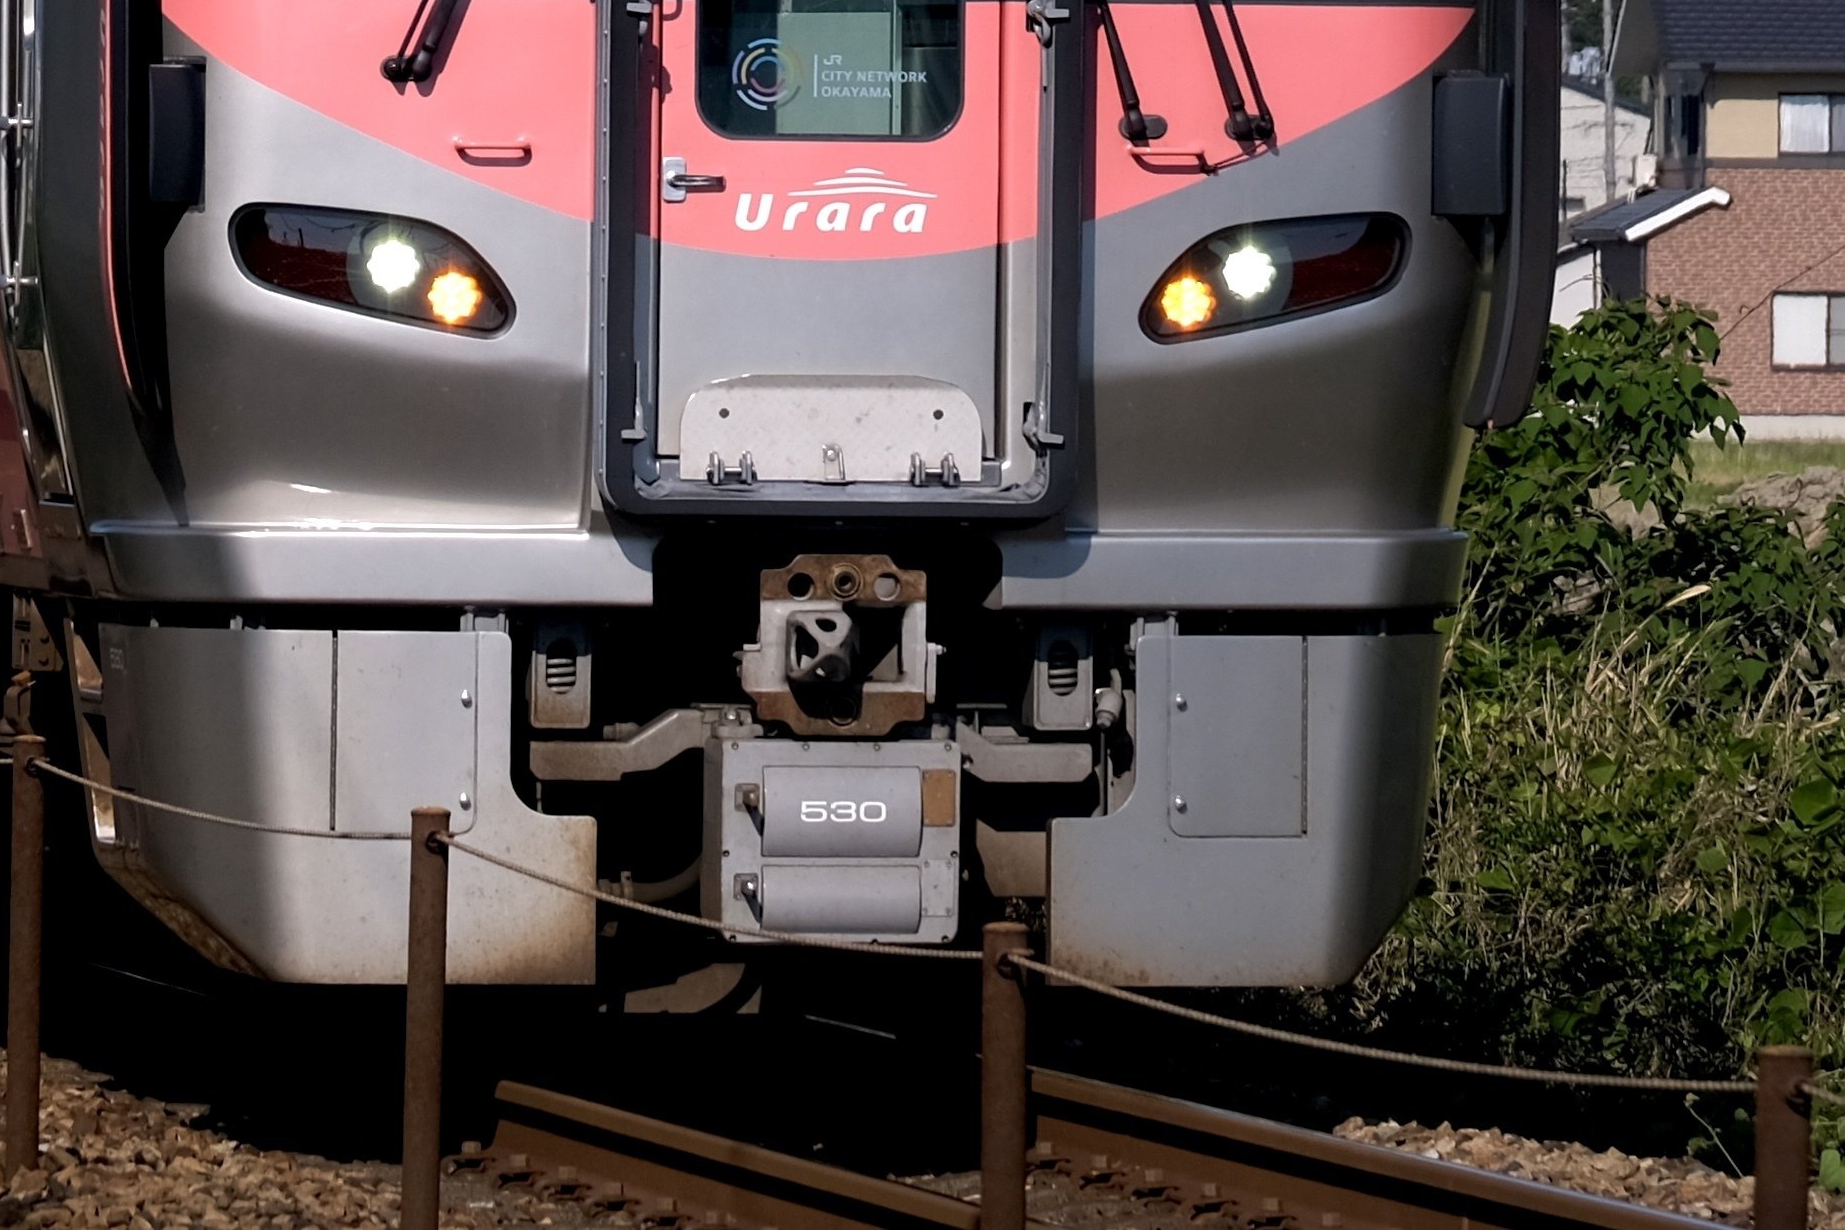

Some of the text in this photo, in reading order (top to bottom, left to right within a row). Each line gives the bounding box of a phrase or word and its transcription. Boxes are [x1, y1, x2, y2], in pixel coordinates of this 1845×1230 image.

[823, 54, 843, 66] JR
[821, 70, 927, 83] CITY NETWORK
[821, 86, 892, 98] OKAYAMA
[735, 193, 927, 233] Urara
[800, 801, 887, 822] 530
